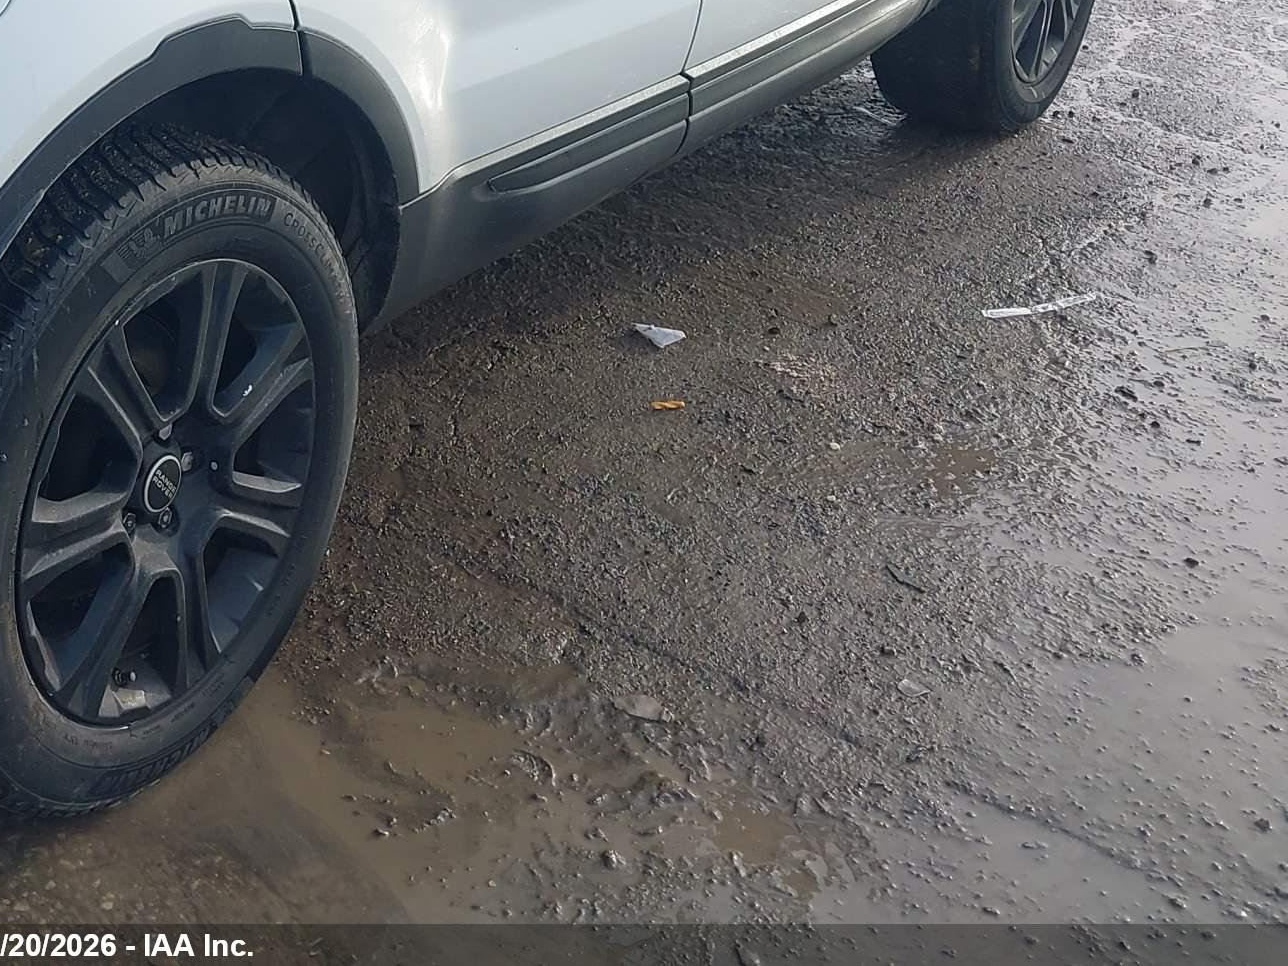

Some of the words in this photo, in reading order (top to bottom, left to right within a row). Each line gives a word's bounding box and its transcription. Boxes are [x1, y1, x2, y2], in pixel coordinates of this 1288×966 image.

[164, 195, 272, 238] MICHELIN
[152, 475, 174, 499] ROVER
[155, 469, 177, 493] RANGE
